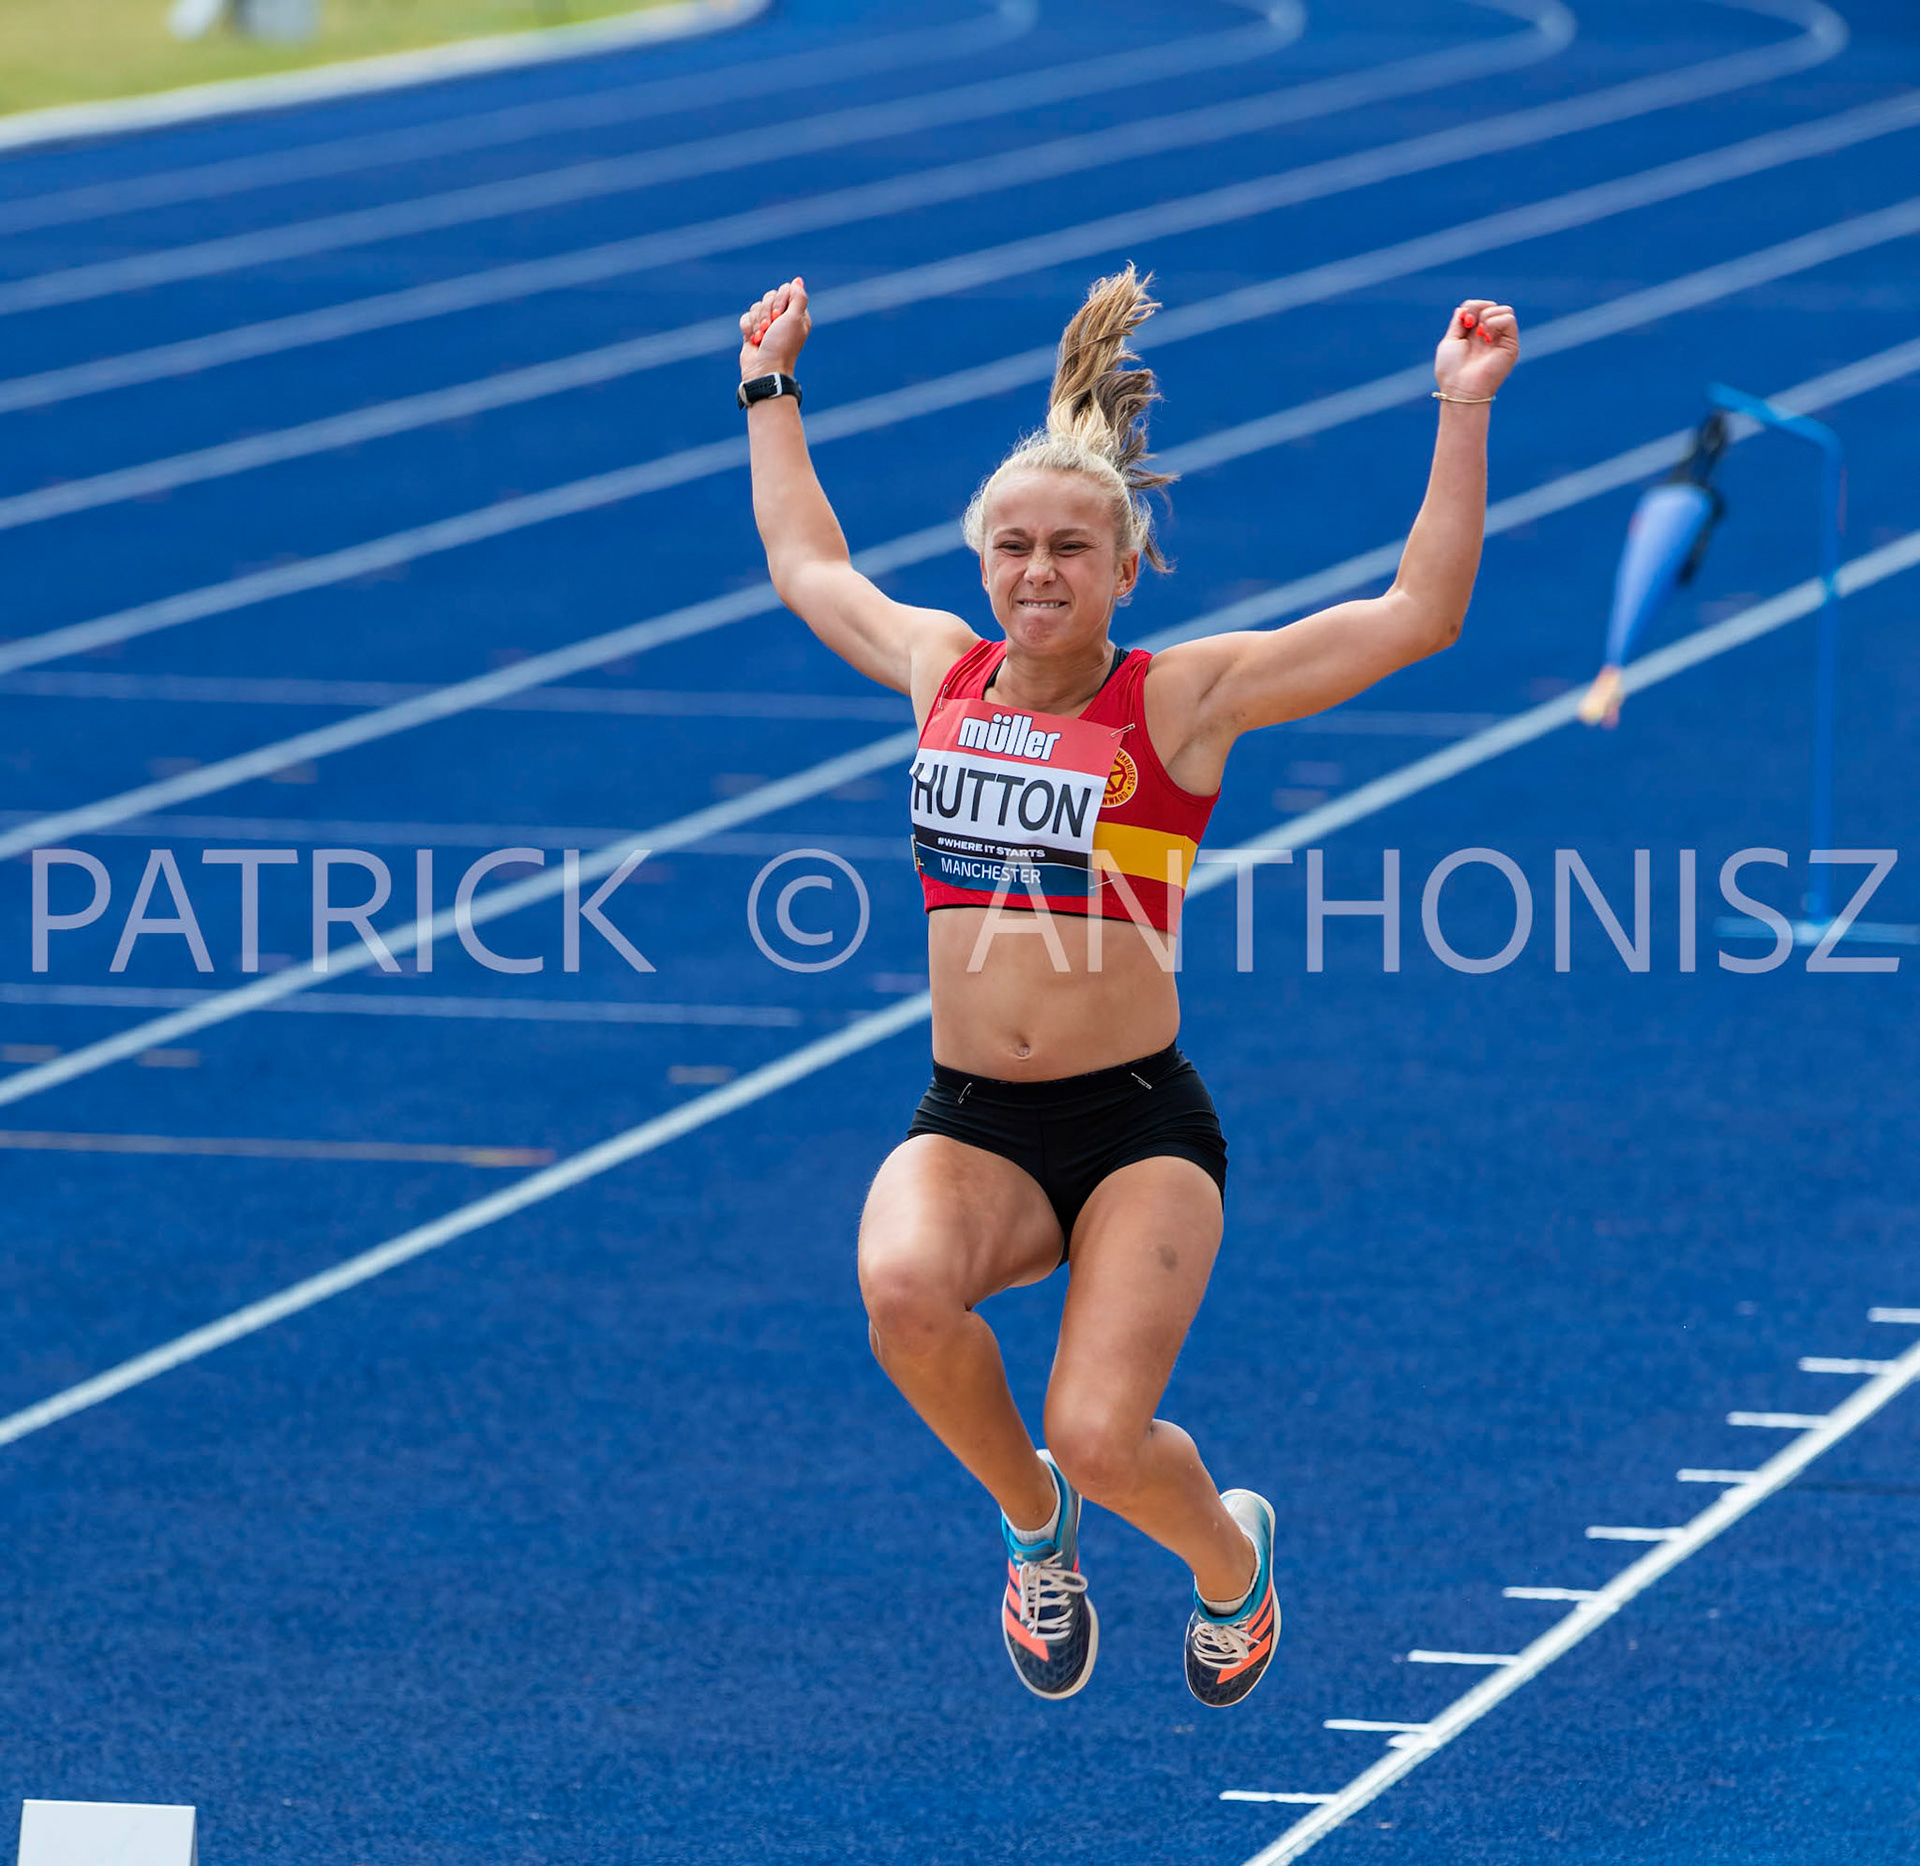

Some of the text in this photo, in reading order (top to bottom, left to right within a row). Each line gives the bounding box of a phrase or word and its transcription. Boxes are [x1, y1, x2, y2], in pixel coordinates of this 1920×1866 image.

[957, 713, 1061, 761] müller
[913, 762, 1091, 838] HUTTON
[937, 837, 1046, 858] #WHERE IT STARTS
[941, 857, 1041, 884] MANCHESTER
